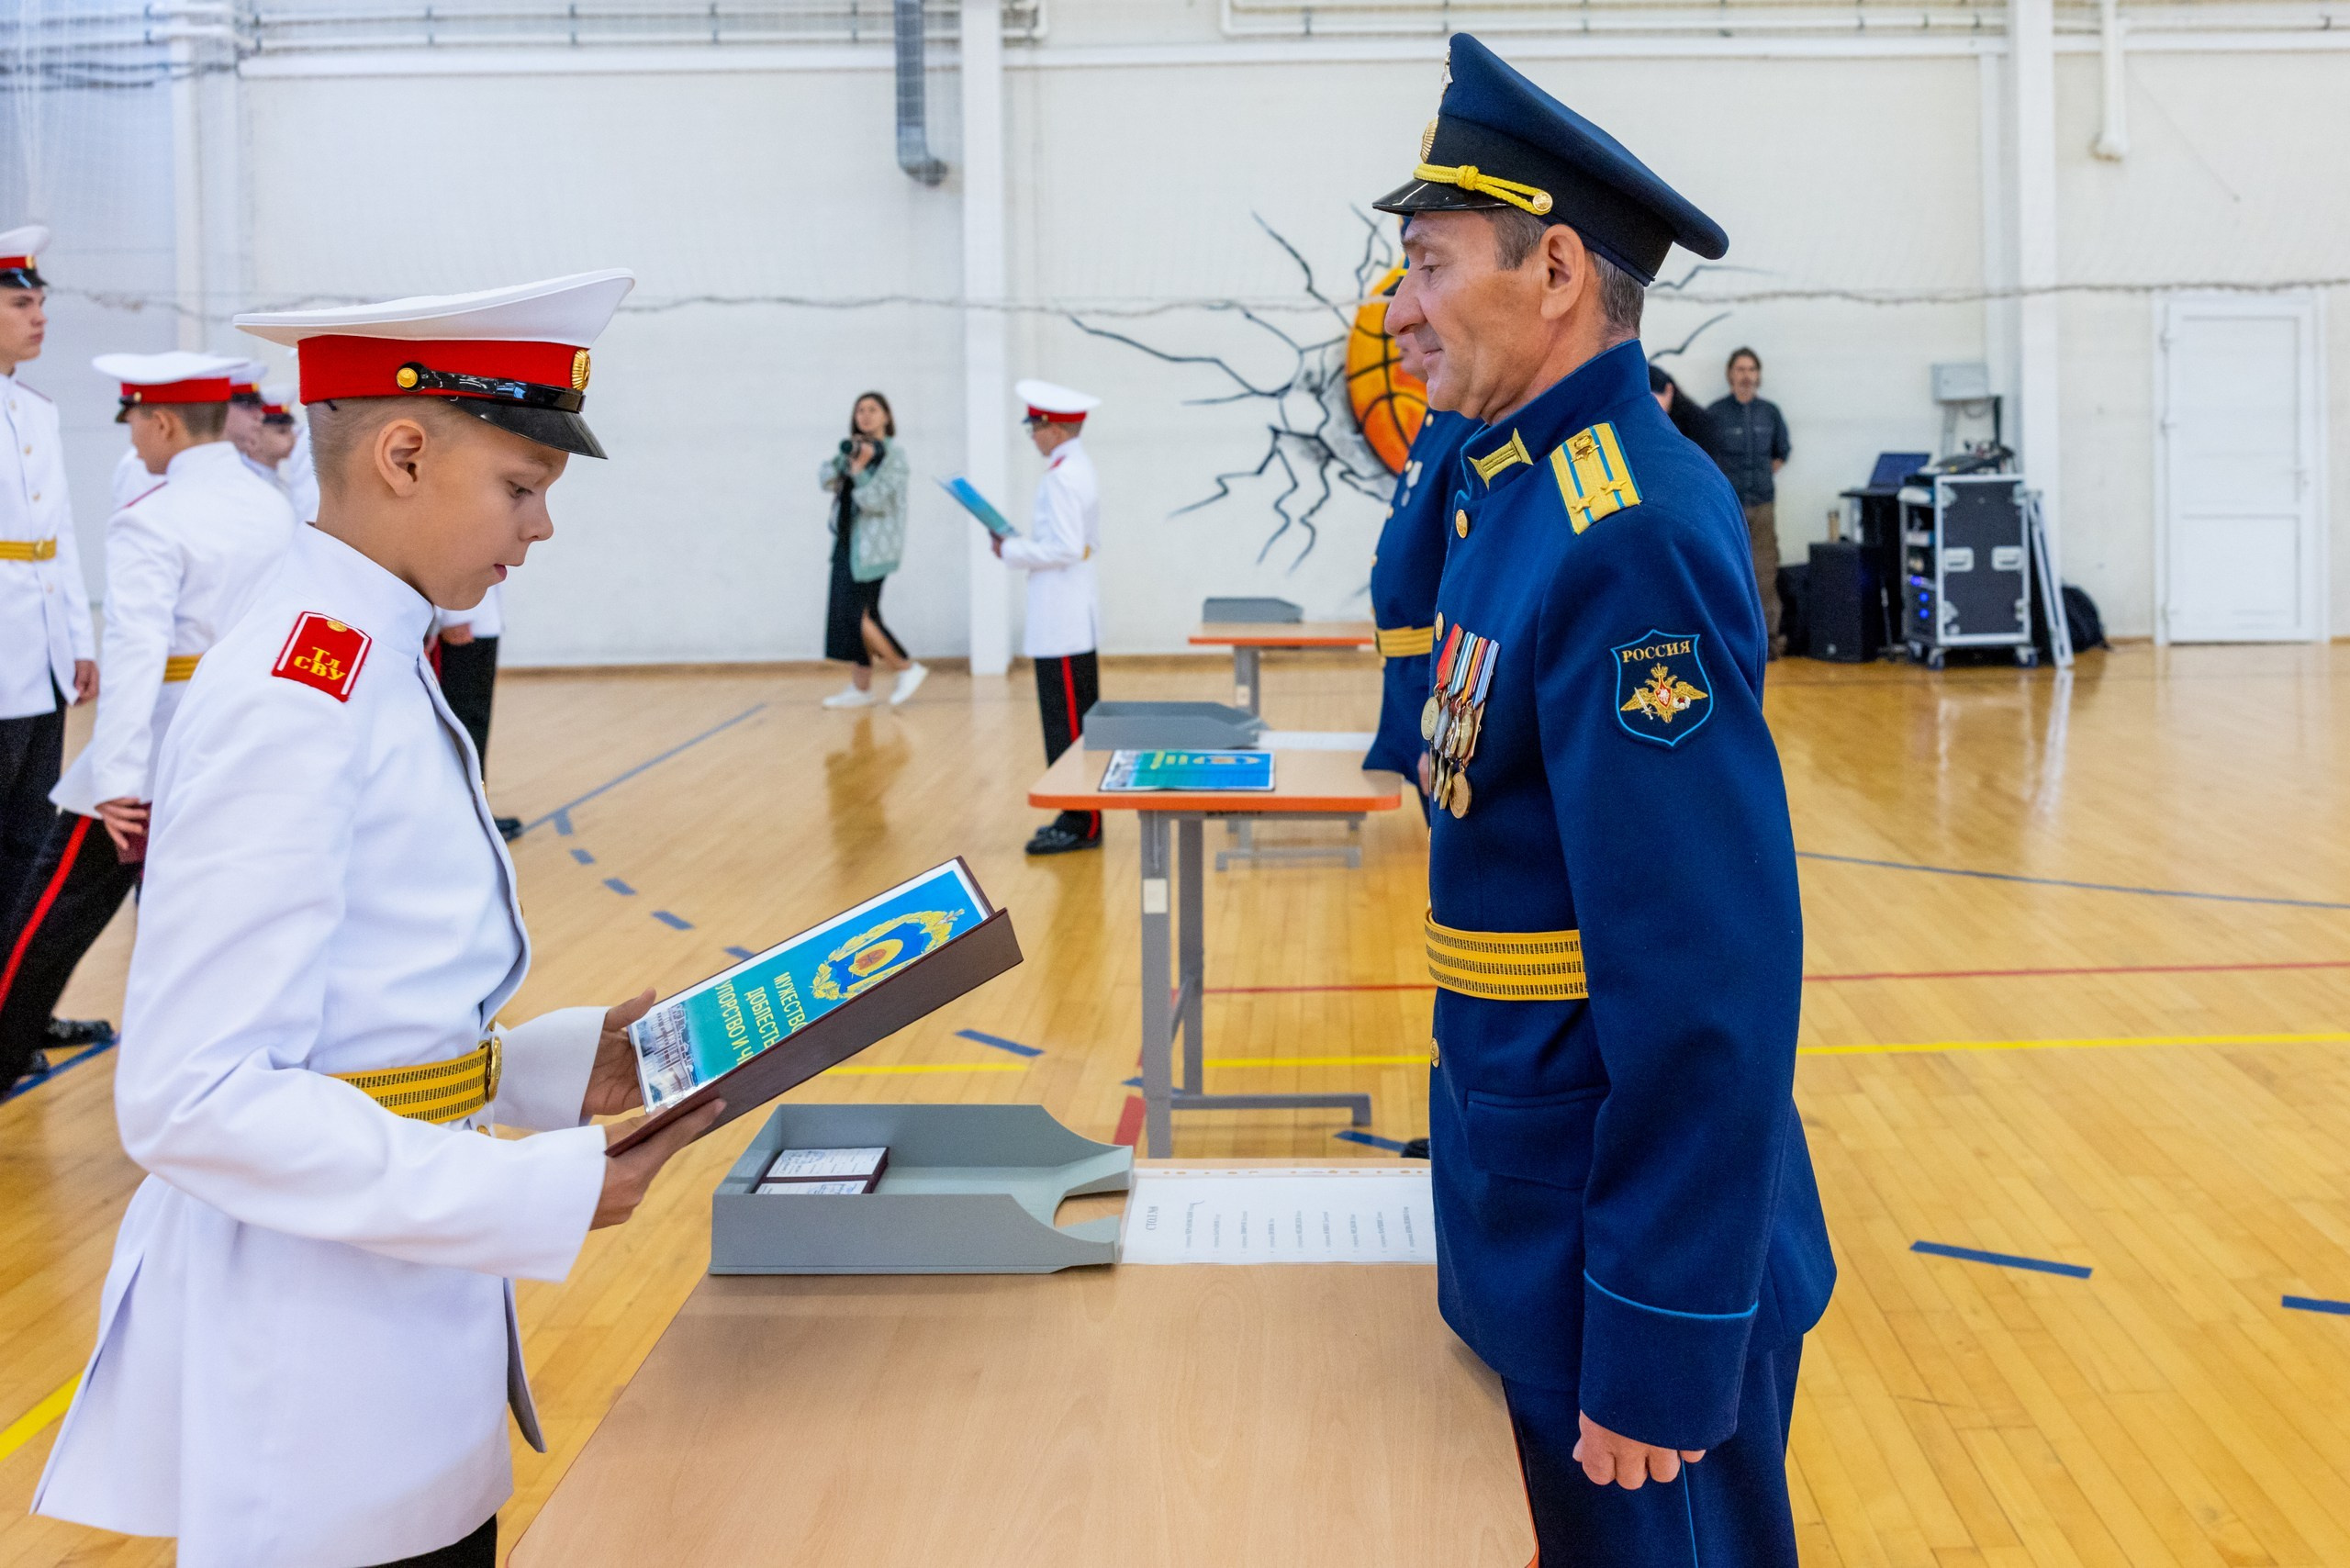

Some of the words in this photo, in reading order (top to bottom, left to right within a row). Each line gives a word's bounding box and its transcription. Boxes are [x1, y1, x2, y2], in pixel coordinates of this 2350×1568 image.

[293, 655, 346, 680] СВУ
[1621, 640, 1691, 663] РОССИЯ
[715, 979, 745, 1038] УПОРСТВО
[732, 1035, 750, 1050] И
[744, 986, 780, 1048] ДОБЛЕСТЬ
